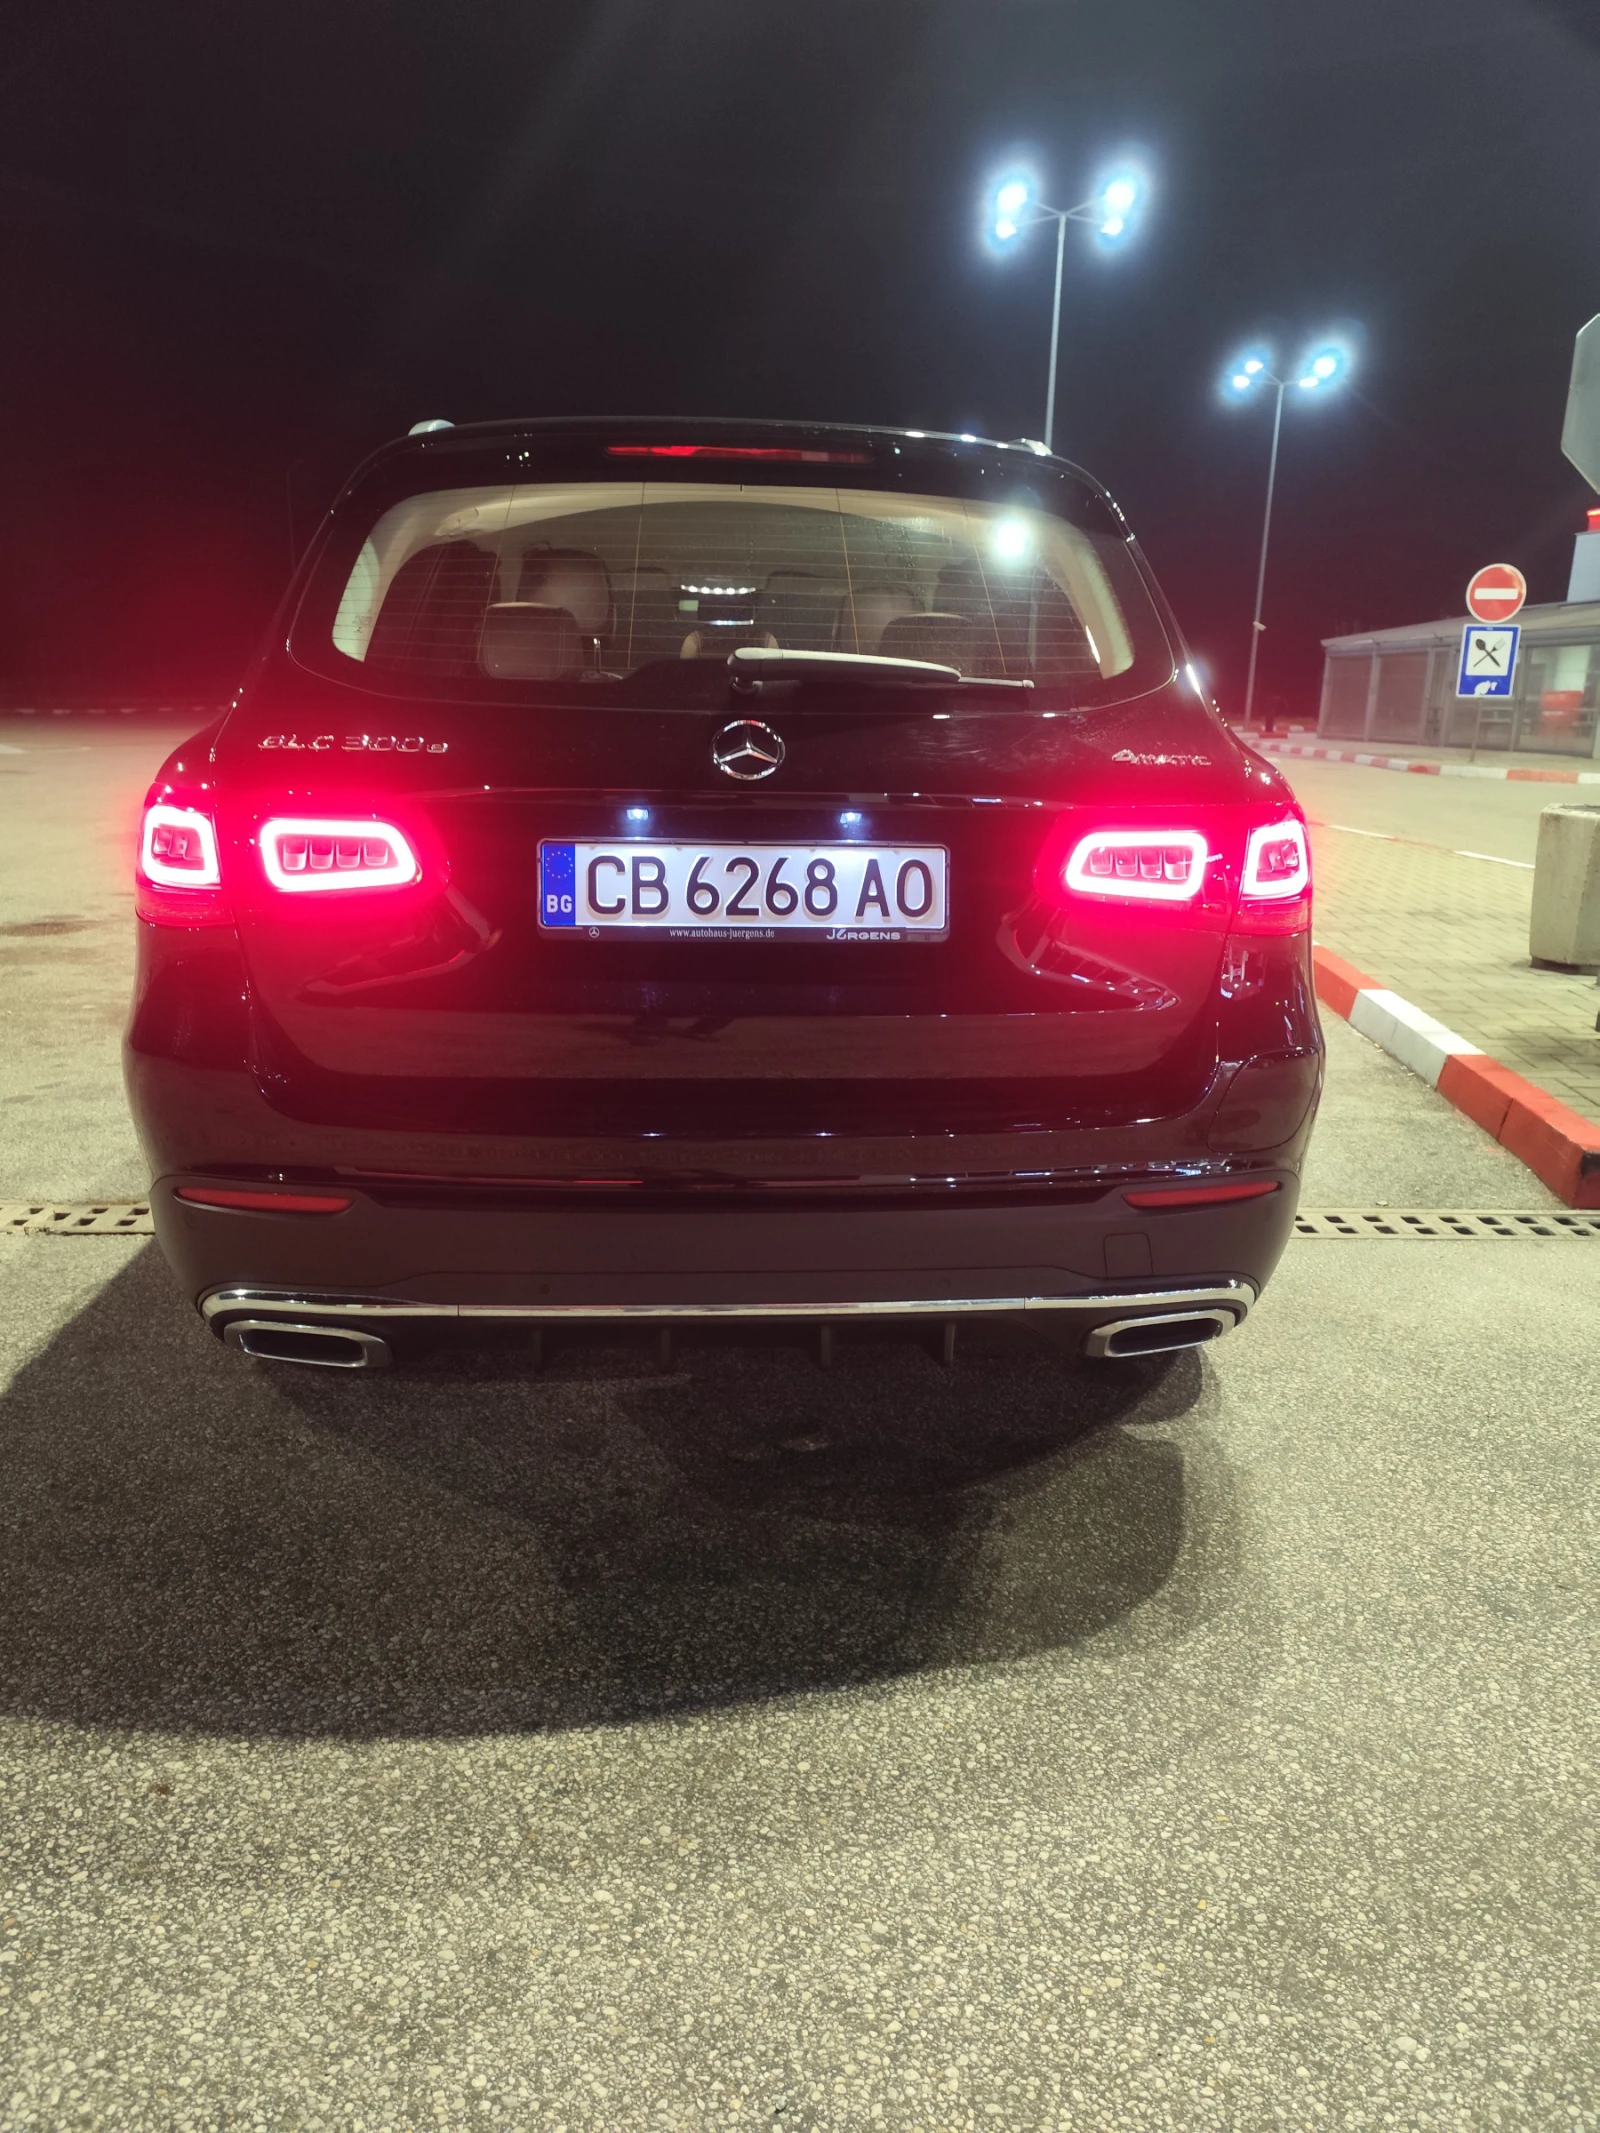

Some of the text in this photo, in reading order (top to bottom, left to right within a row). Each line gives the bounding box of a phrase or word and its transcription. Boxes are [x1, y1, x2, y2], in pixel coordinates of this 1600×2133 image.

[258, 734, 334, 751] GLC
[588, 855, 669, 915] CB
[686, 856, 838, 917] 6268
[546, 894, 573, 913] BG
[669, 928, 775, 939] www.autohaus-juergens.de
